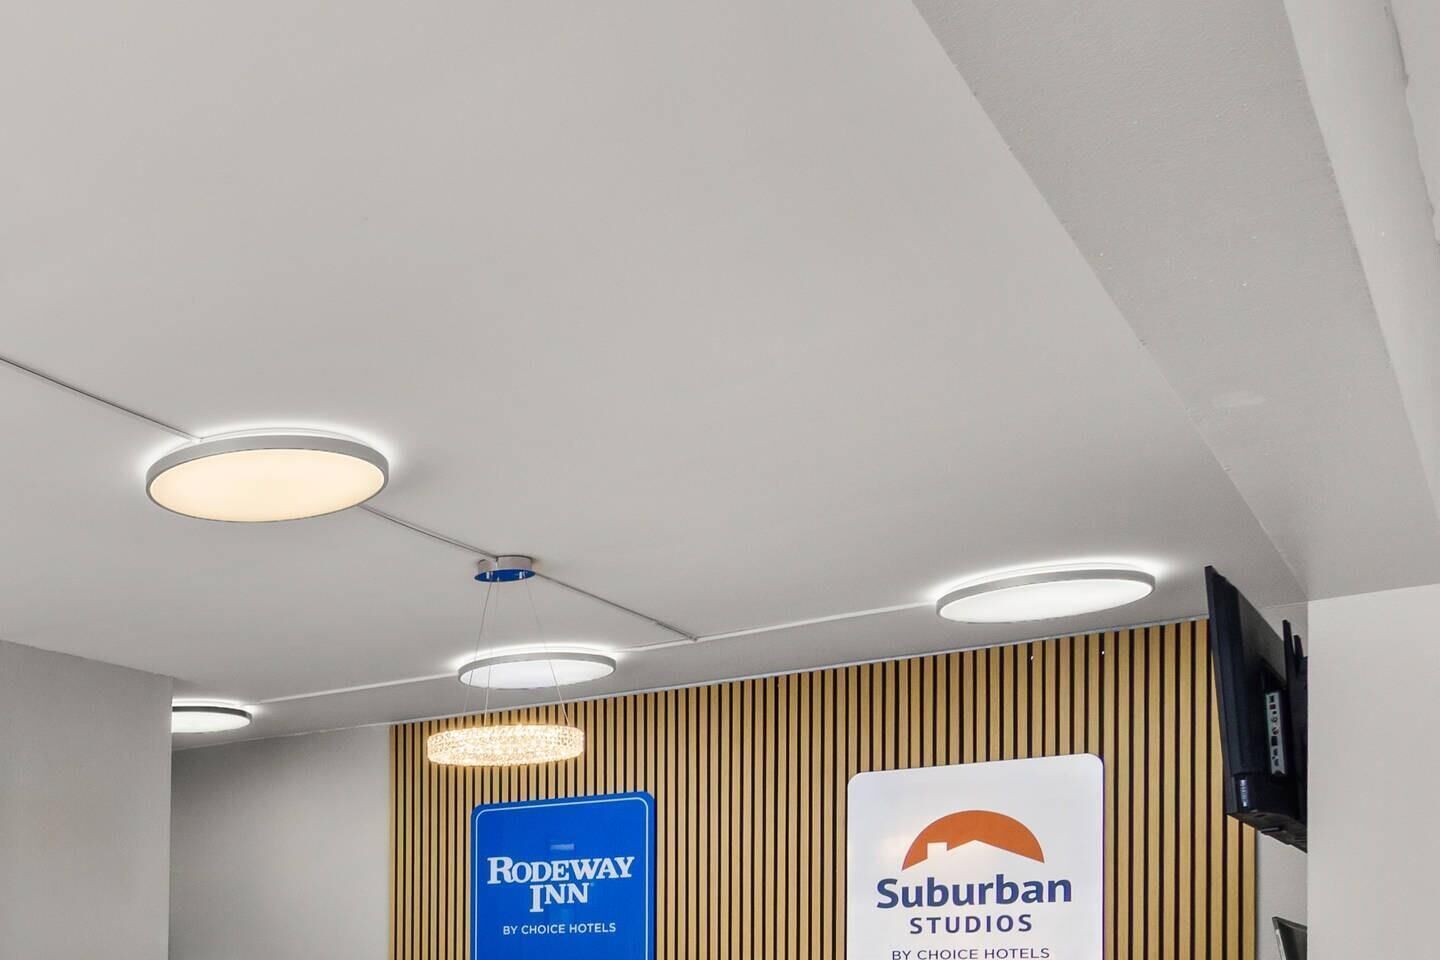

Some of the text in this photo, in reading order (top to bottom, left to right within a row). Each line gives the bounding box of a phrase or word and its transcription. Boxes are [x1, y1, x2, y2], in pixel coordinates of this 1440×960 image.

[529, 882, 589, 912] INN
[876, 873, 1073, 909] Suburban
[503, 922, 617, 935] BY CHOICE HOTELS
[909, 914, 1033, 934] STUDIOS
[891, 947, 1050, 960] BY CHOICE HOTELS
